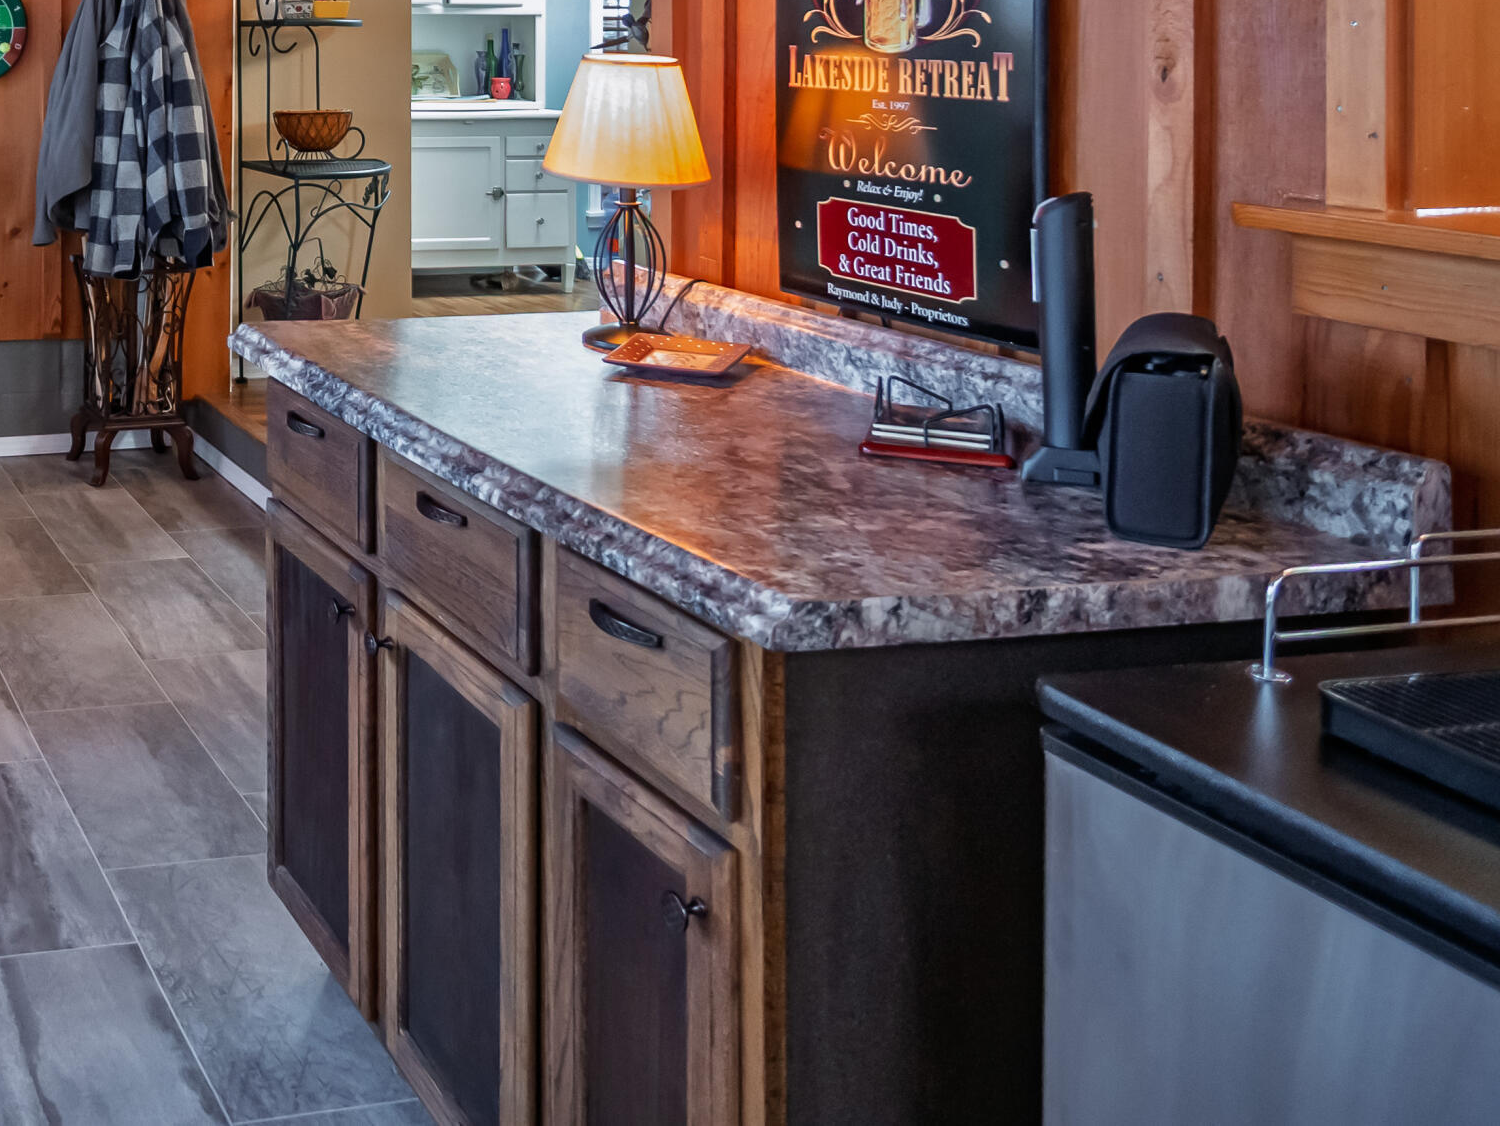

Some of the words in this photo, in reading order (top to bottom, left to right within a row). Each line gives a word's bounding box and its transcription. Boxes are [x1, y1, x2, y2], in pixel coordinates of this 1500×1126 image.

[788, 45, 890, 93] LAKESIDE
[898, 52, 1015, 102] RETREAT
[819, 126, 972, 188] Welcome
[856, 179, 882, 194] Relax
[882, 184, 893, 196] &
[893, 185, 924, 204] Enjoy!
[847, 206, 886, 231] Good
[888, 213, 940, 243] Times,
[847, 231, 881, 255] Cold
[884, 237, 940, 269] Drinks,
[838, 253, 851, 273] &
[853, 256, 892, 282] Great
[894, 264, 952, 295] Friends
[827, 282, 869, 304] Raymond
[870, 292, 881, 306] &
[881, 295, 903, 314] Judy
[911, 302, 970, 327] Proprietors
